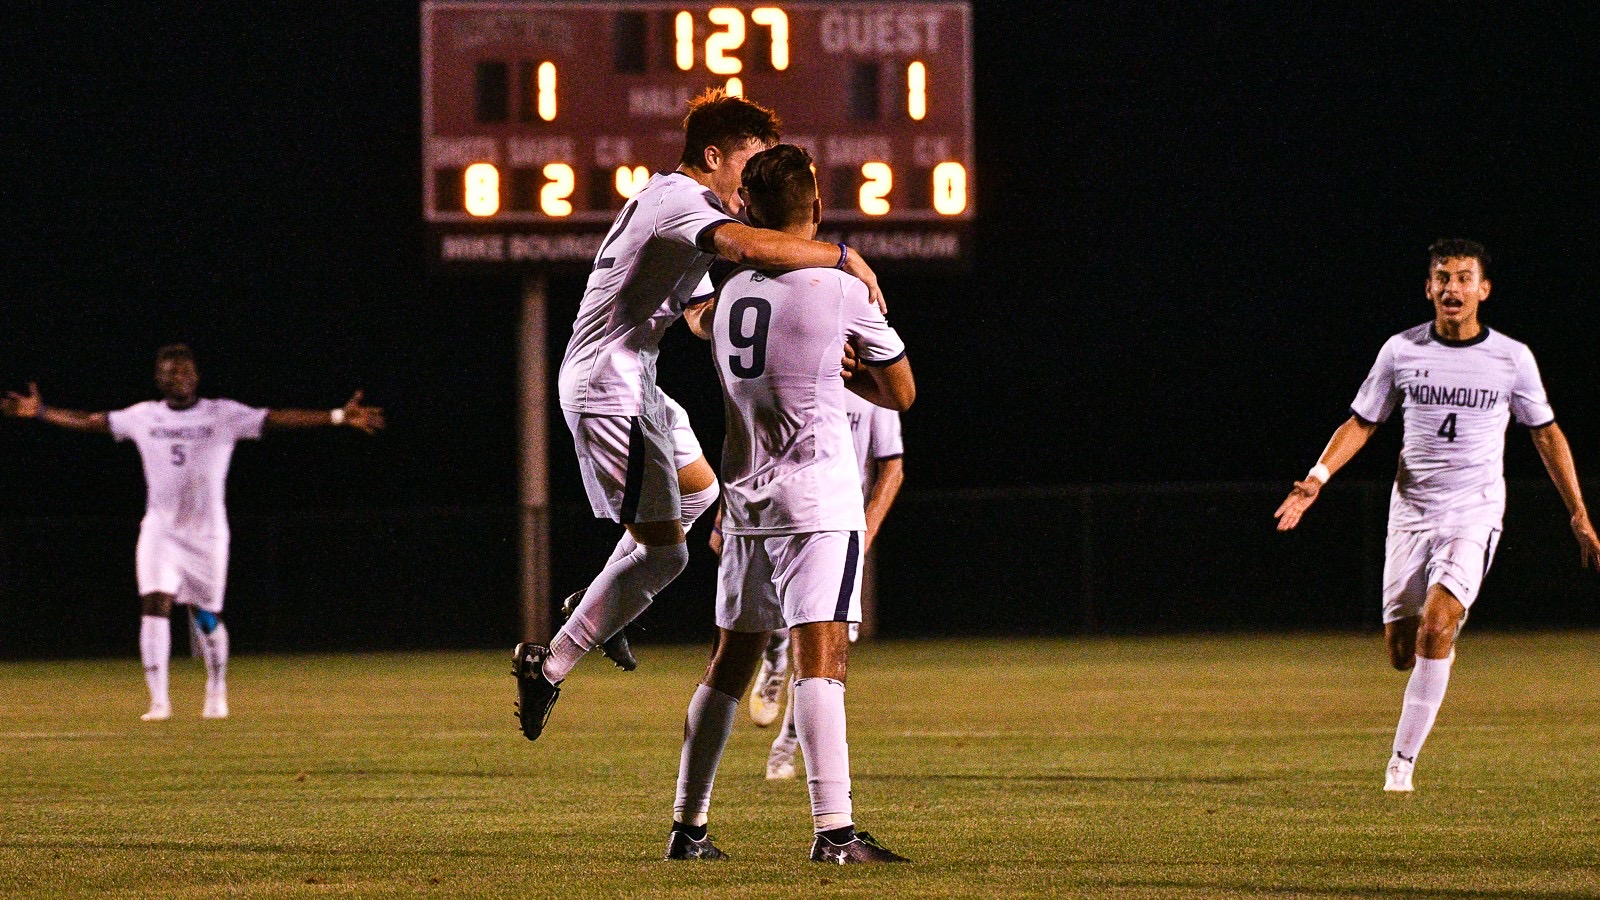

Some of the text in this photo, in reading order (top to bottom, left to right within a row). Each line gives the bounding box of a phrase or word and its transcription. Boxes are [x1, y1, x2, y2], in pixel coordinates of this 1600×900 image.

[821, 12, 940, 52] GUEST
[538, 61, 557, 121] 1
[908, 61, 926, 120] 1
[464, 162, 500, 217] 8
[540, 162, 575, 217] 2
[858, 162, 893, 215] 2
[932, 162, 967, 215] 0
[729, 296, 772, 380] 9
[1408, 384, 1499, 410] MONMOUTH
[1437, 412, 1458, 443] 4
[169, 443, 187, 467] 5
